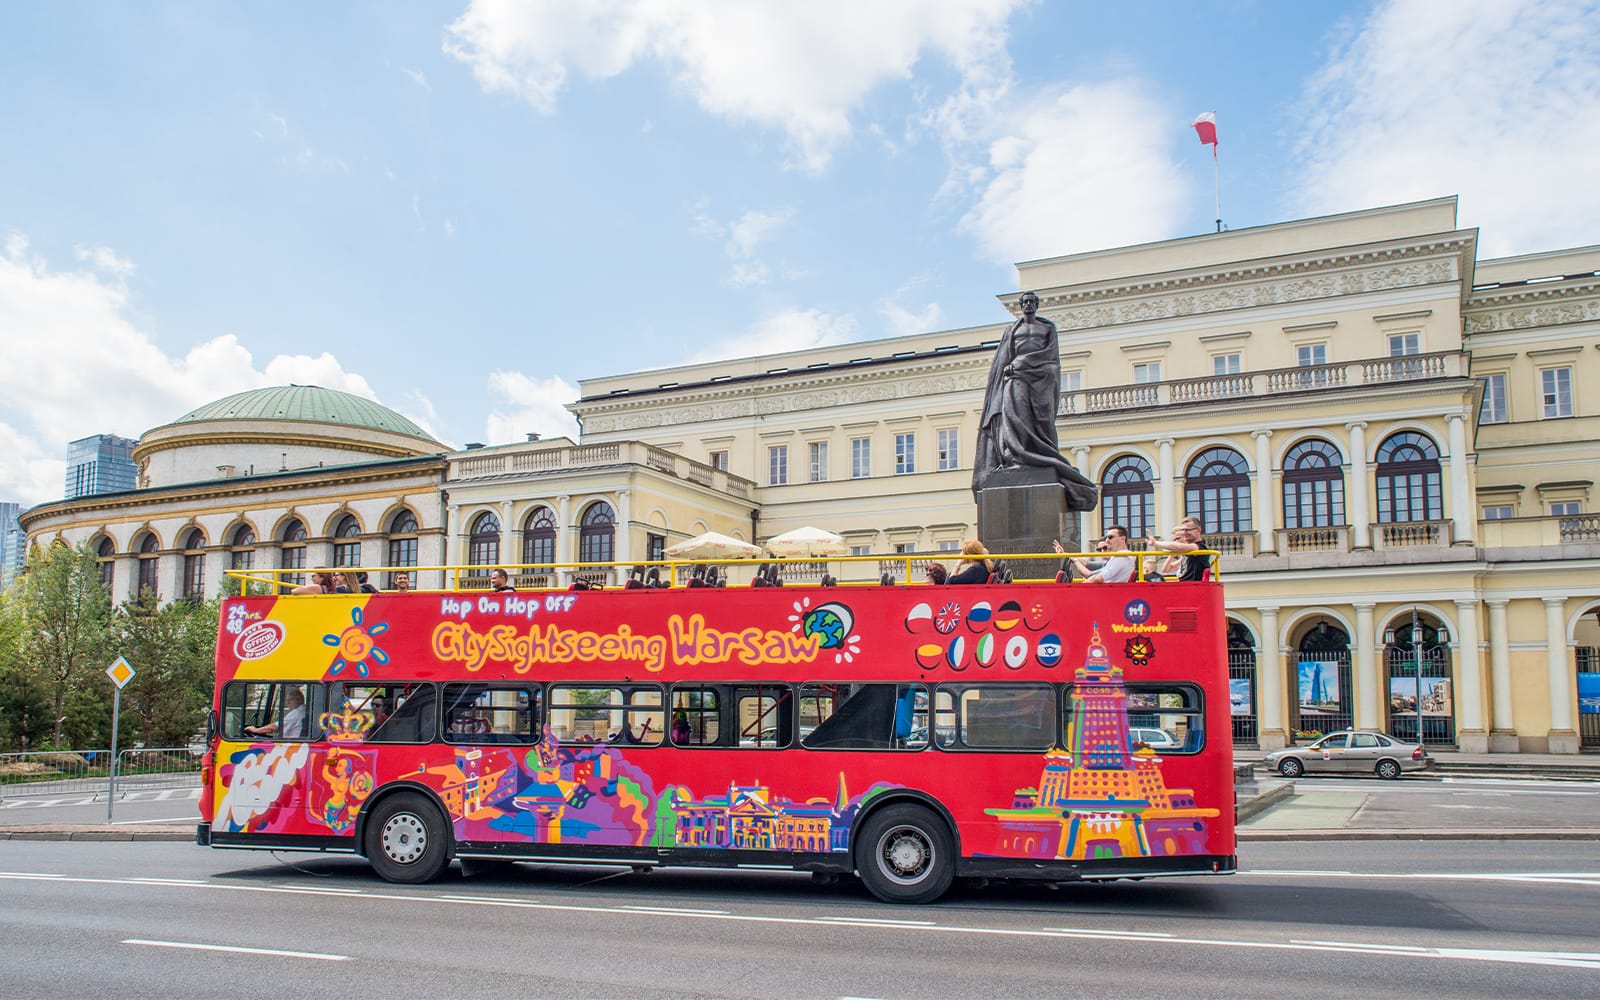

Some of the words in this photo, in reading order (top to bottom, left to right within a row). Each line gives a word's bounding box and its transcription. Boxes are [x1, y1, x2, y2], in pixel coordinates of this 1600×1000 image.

[228, 604, 246, 619] 24
[441, 597, 473, 620] Hop
[478, 596, 500, 614] On
[504, 596, 540, 620] Hop
[226, 619, 243, 634] 48
[246, 632, 274, 649] OFFICIAL
[255, 637, 279, 657] WARSAW
[668, 613, 821, 666] Warsaw
